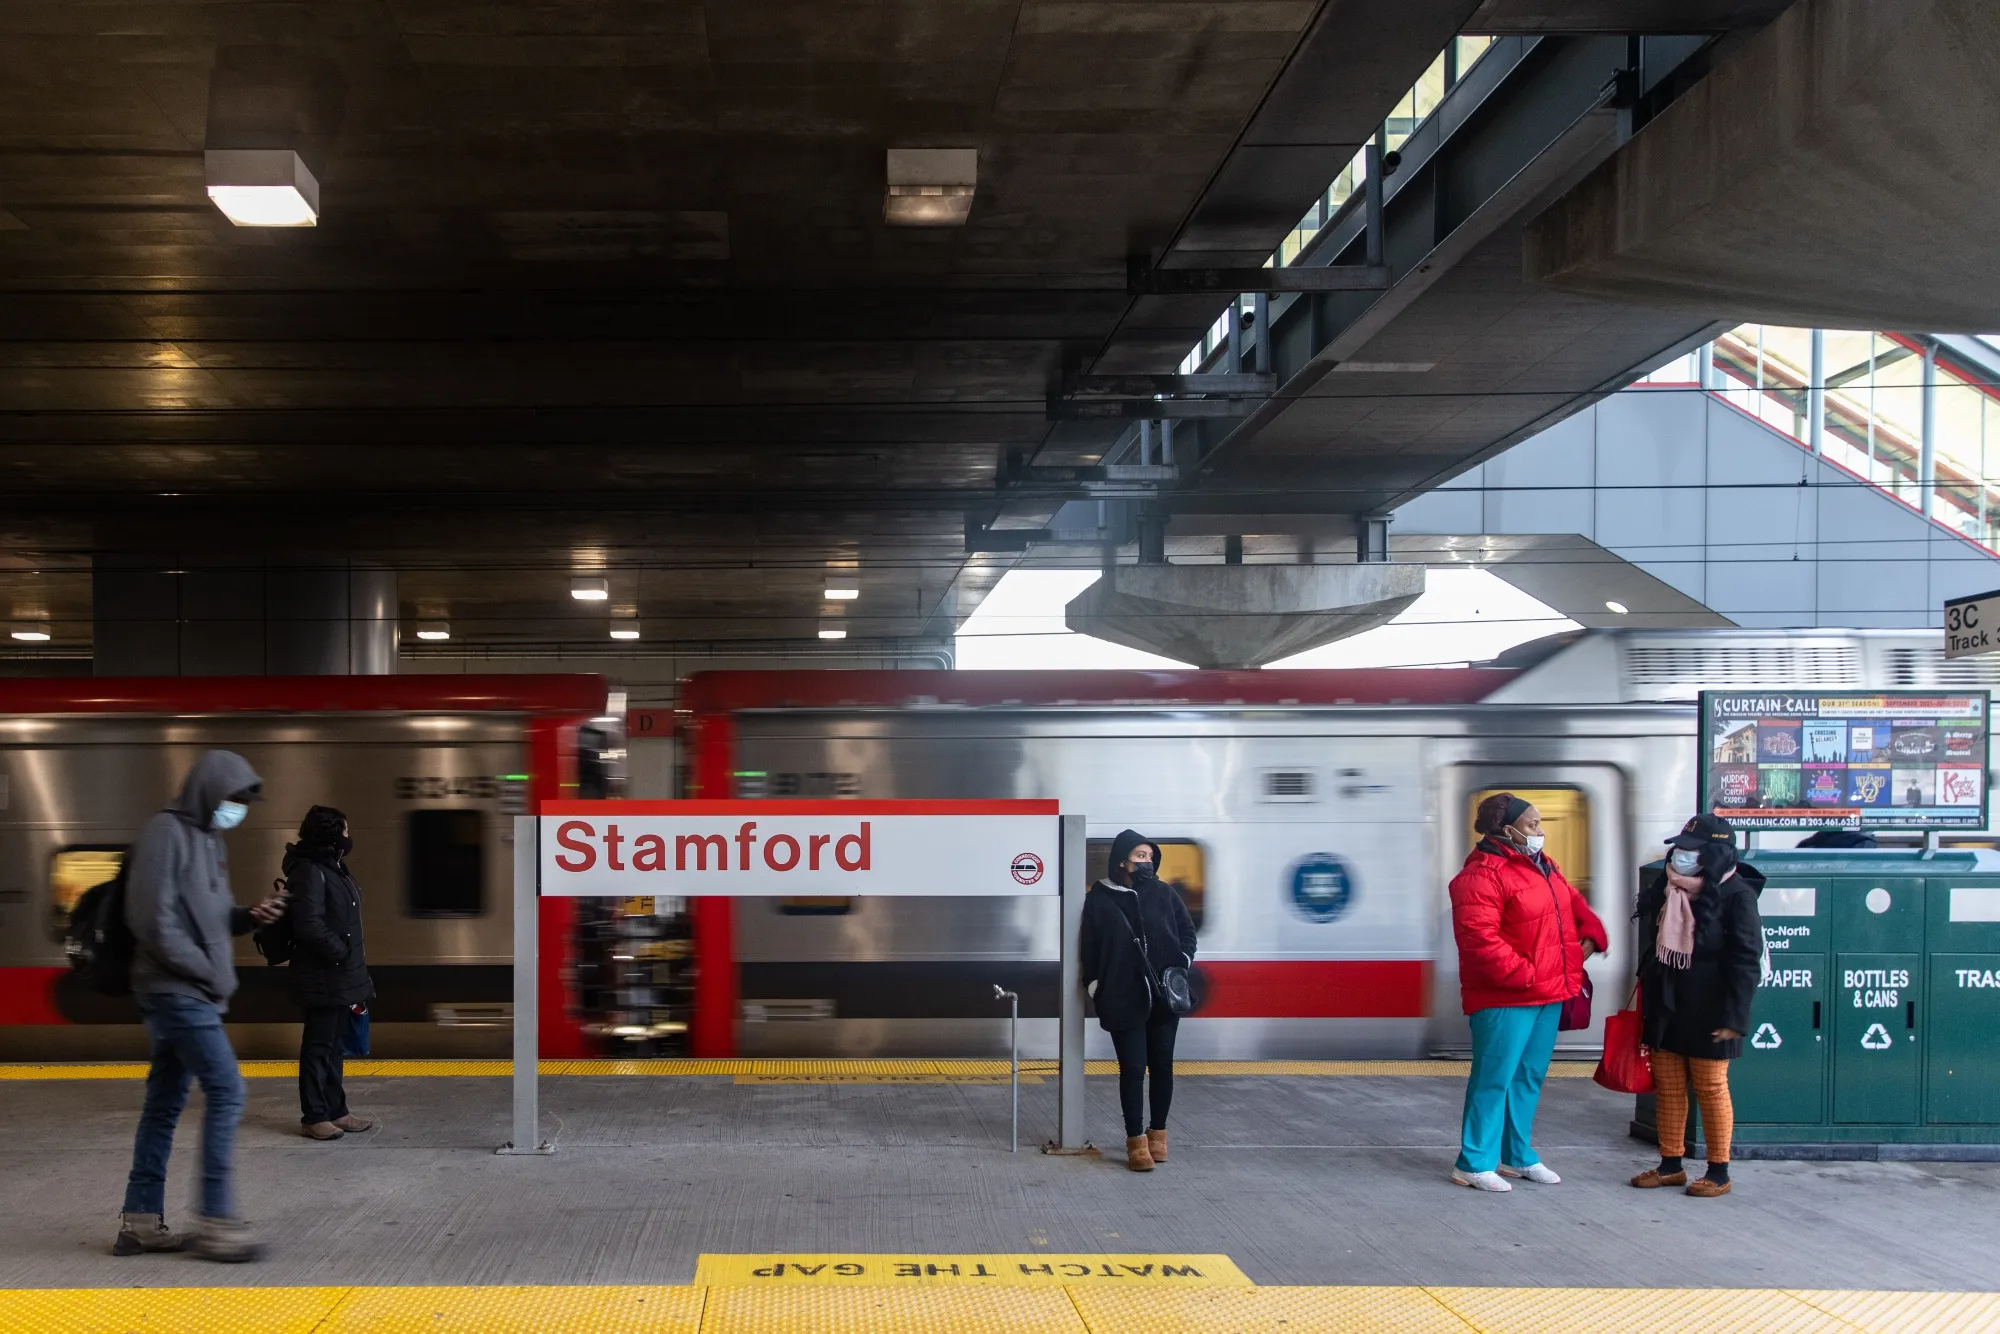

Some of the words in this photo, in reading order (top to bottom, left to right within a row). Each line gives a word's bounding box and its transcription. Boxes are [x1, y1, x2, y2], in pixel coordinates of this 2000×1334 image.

[1948, 604, 1979, 631] 3C
[1949, 630, 1989, 651] Track
[1722, 698, 1781, 712] CURTAIN
[1786, 698, 1818, 712] CALL
[640, 715, 654, 731] D
[1720, 774, 1750, 790] MURDER
[1725, 817, 1798, 826] TAINCALLINC.COM
[1808, 817, 1860, 827] 203.461.6358
[554, 821, 872, 872] Stamford
[1763, 925, 1811, 936] ro-North
[1757, 969, 1812, 988] PAPER
[1843, 969, 1909, 988] BOTTLES
[1853, 990, 1862, 1008] &
[1864, 989, 1898, 1008] CANS
[752, 1263, 865, 1277] GAP
[892, 1263, 997, 1277] THE
[1018, 1263, 1207, 1278] WATCH
